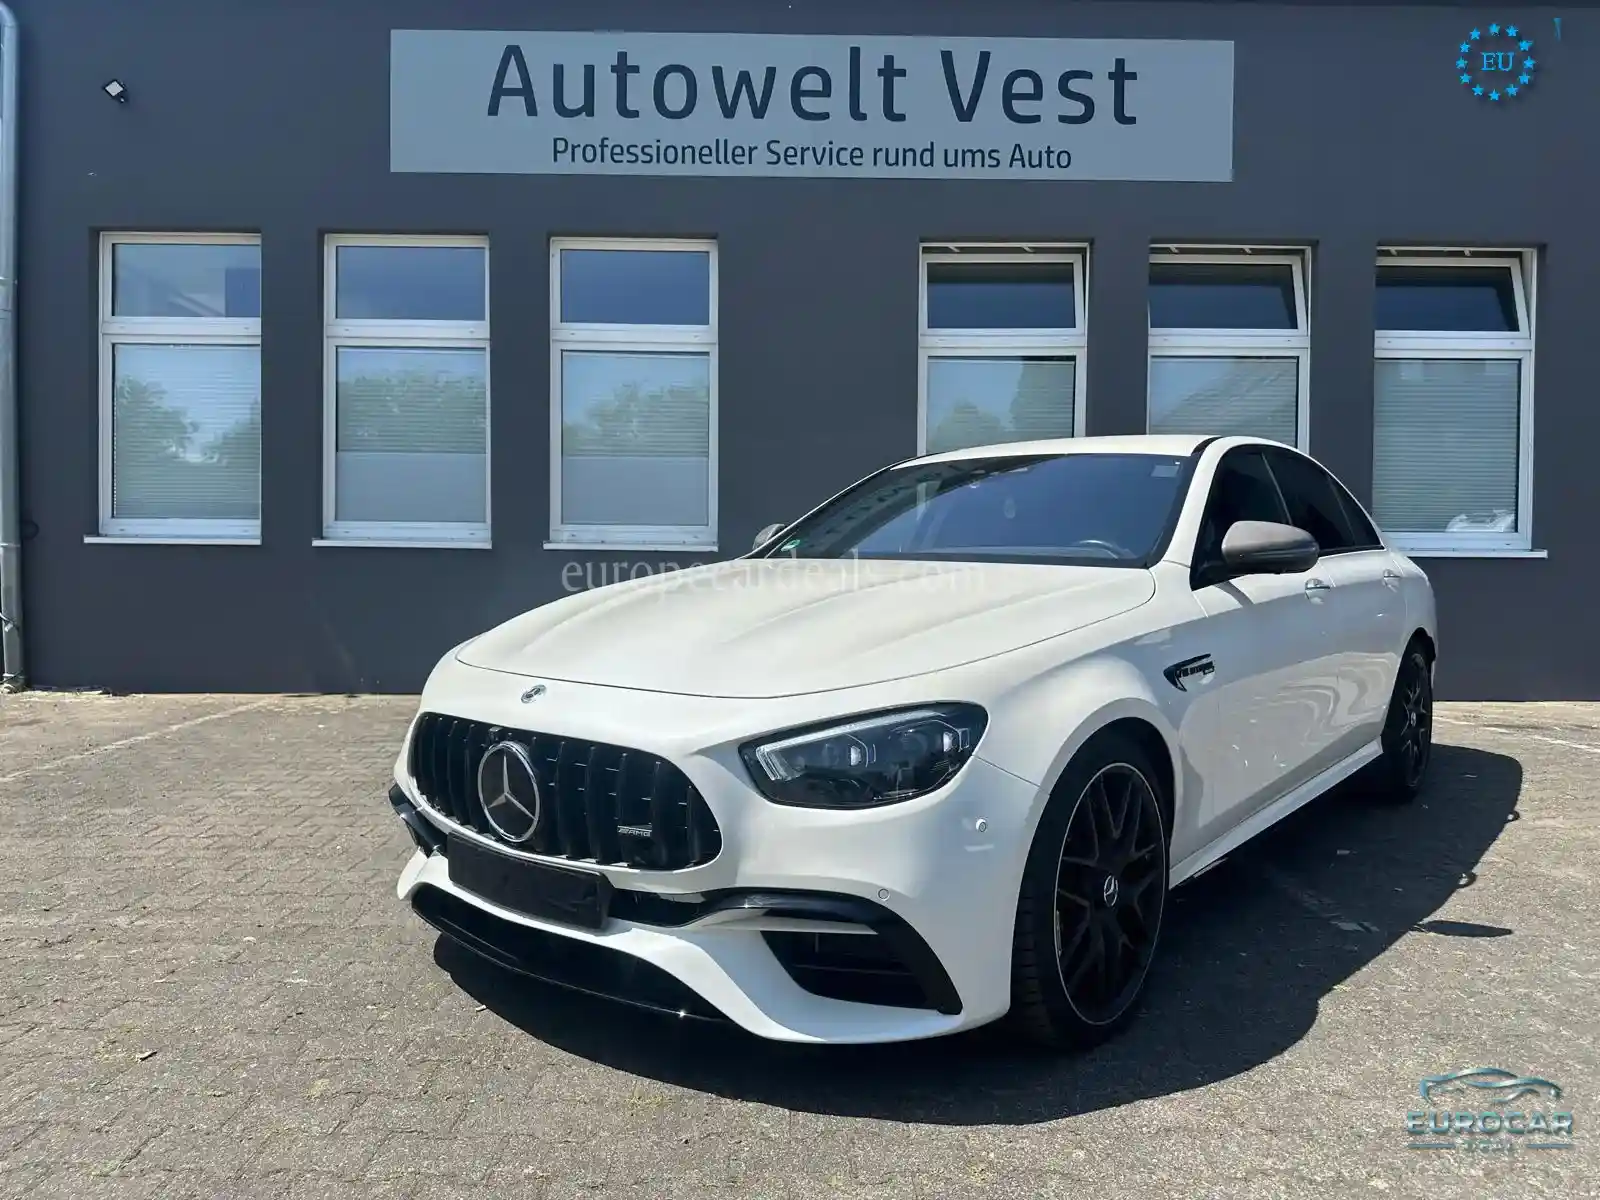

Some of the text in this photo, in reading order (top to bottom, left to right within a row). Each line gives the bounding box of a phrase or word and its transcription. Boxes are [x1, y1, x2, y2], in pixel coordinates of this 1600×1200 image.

[487, 44, 1138, 125] Autowelt Vest
[552, 137, 1072, 169] Professioneller Service rund ums Auto
